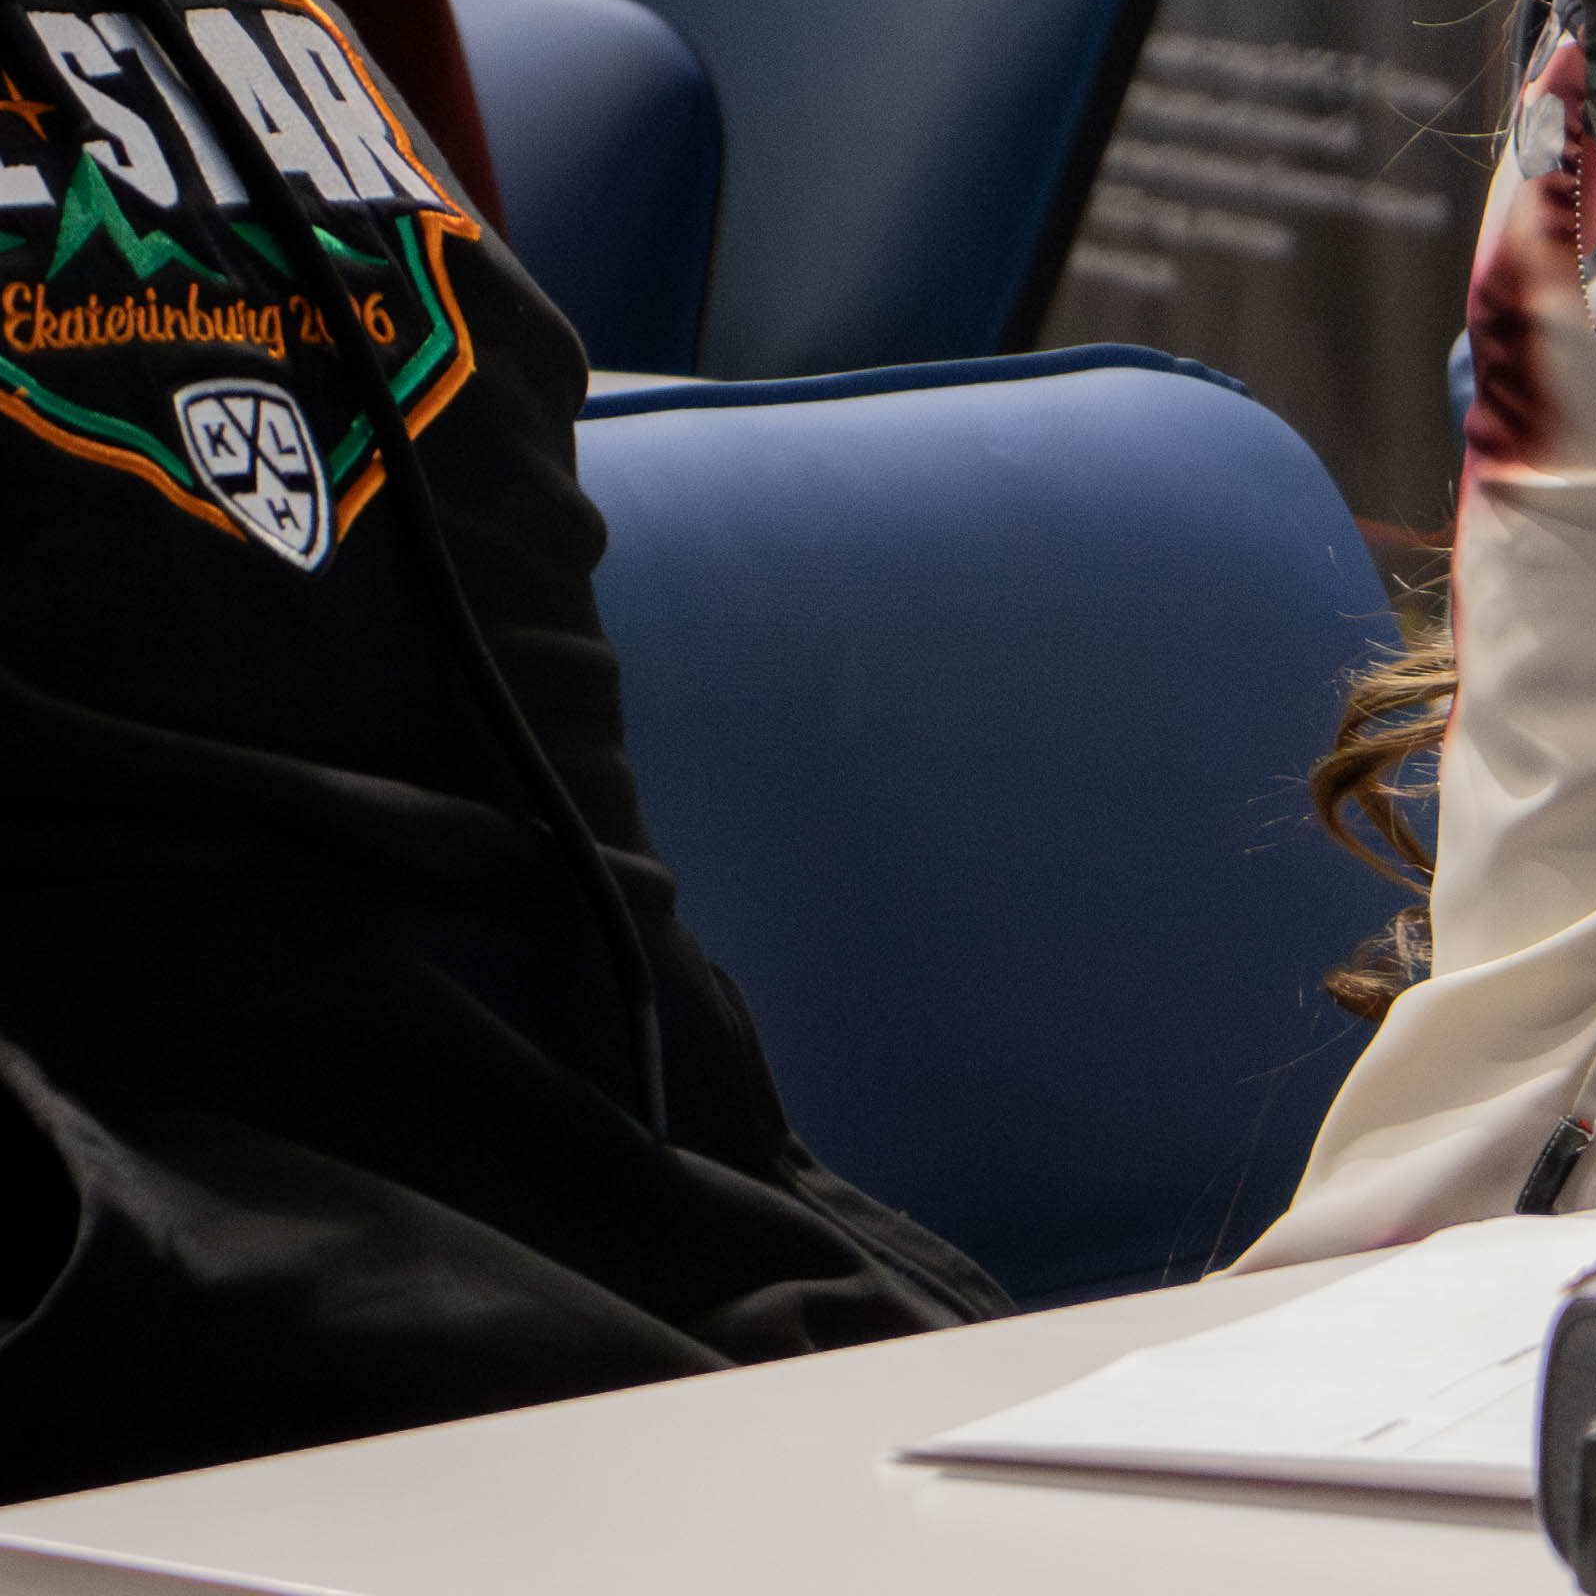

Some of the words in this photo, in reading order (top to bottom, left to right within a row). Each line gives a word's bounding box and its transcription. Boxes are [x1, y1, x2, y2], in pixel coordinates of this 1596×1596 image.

[26, 7, 441, 206] STAR
[2, 282, 286, 360] Ekaterinburg
[289, 291, 396, 344] 26
